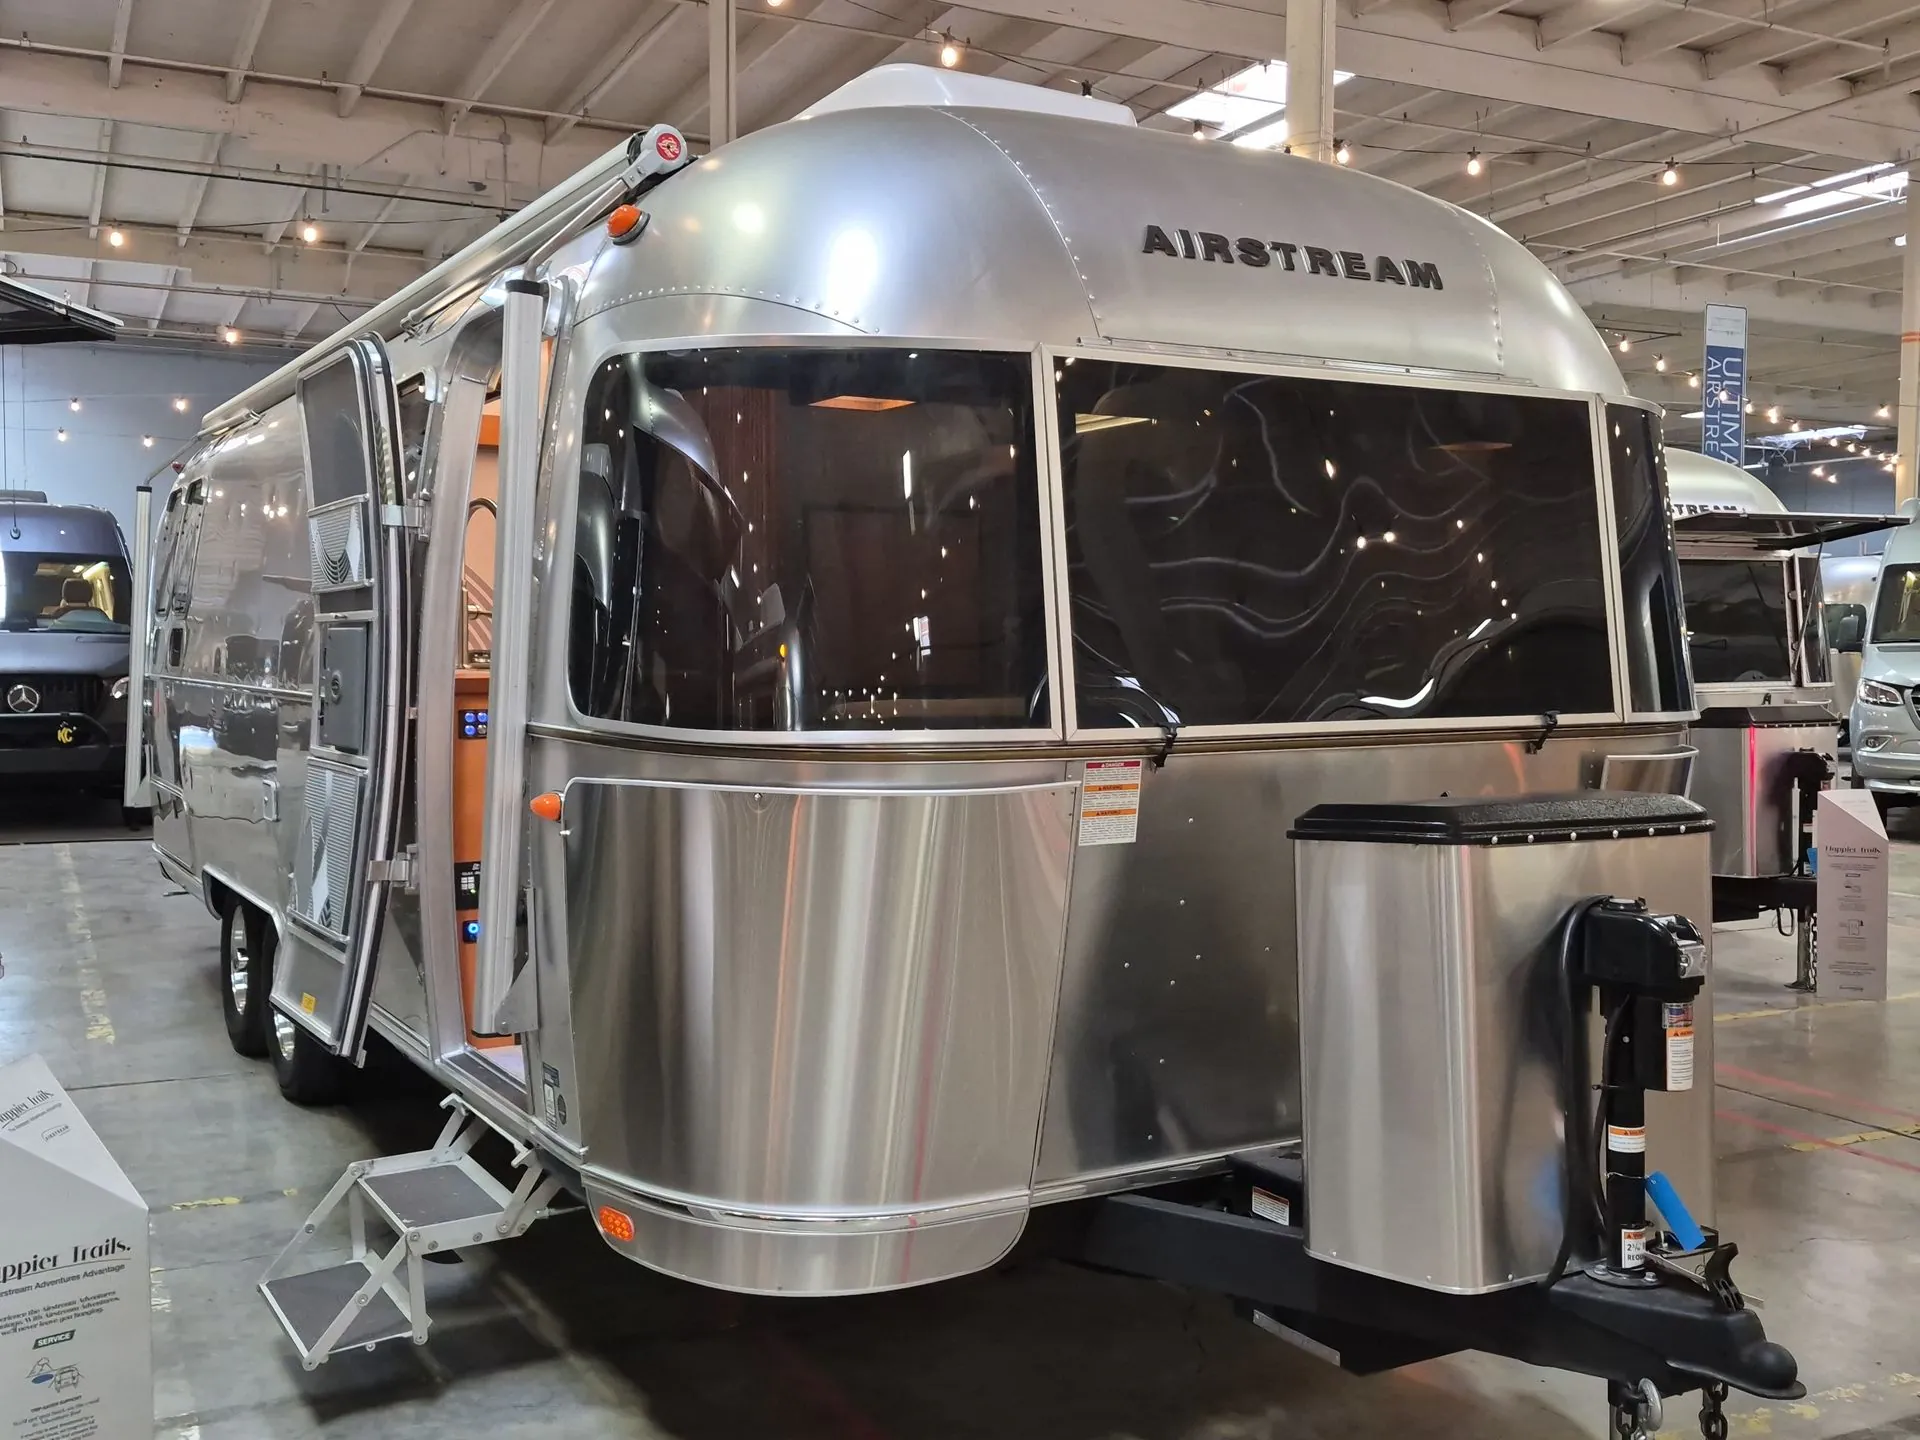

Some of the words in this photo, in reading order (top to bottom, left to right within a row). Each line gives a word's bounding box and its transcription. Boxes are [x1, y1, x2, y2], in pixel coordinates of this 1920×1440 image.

[1142, 224, 1444, 290] AIRSTREAM
[1705, 356, 1722, 455] AIRSTRE
[1720, 356, 1742, 467] ULTIMA
[1671, 503, 1737, 516] TREAM
[57, 727, 73, 744] KC
[0, 1102, 29, 1122] appier
[0, 1254, 58, 1283] ppier
[72, 1237, 131, 1263] Trails.
[0, 1285, 33, 1297] rstream
[34, 1273, 81, 1290] Adventures
[82, 1263, 125, 1280] Advantage
[38, 1332, 72, 1347] SERVICE
